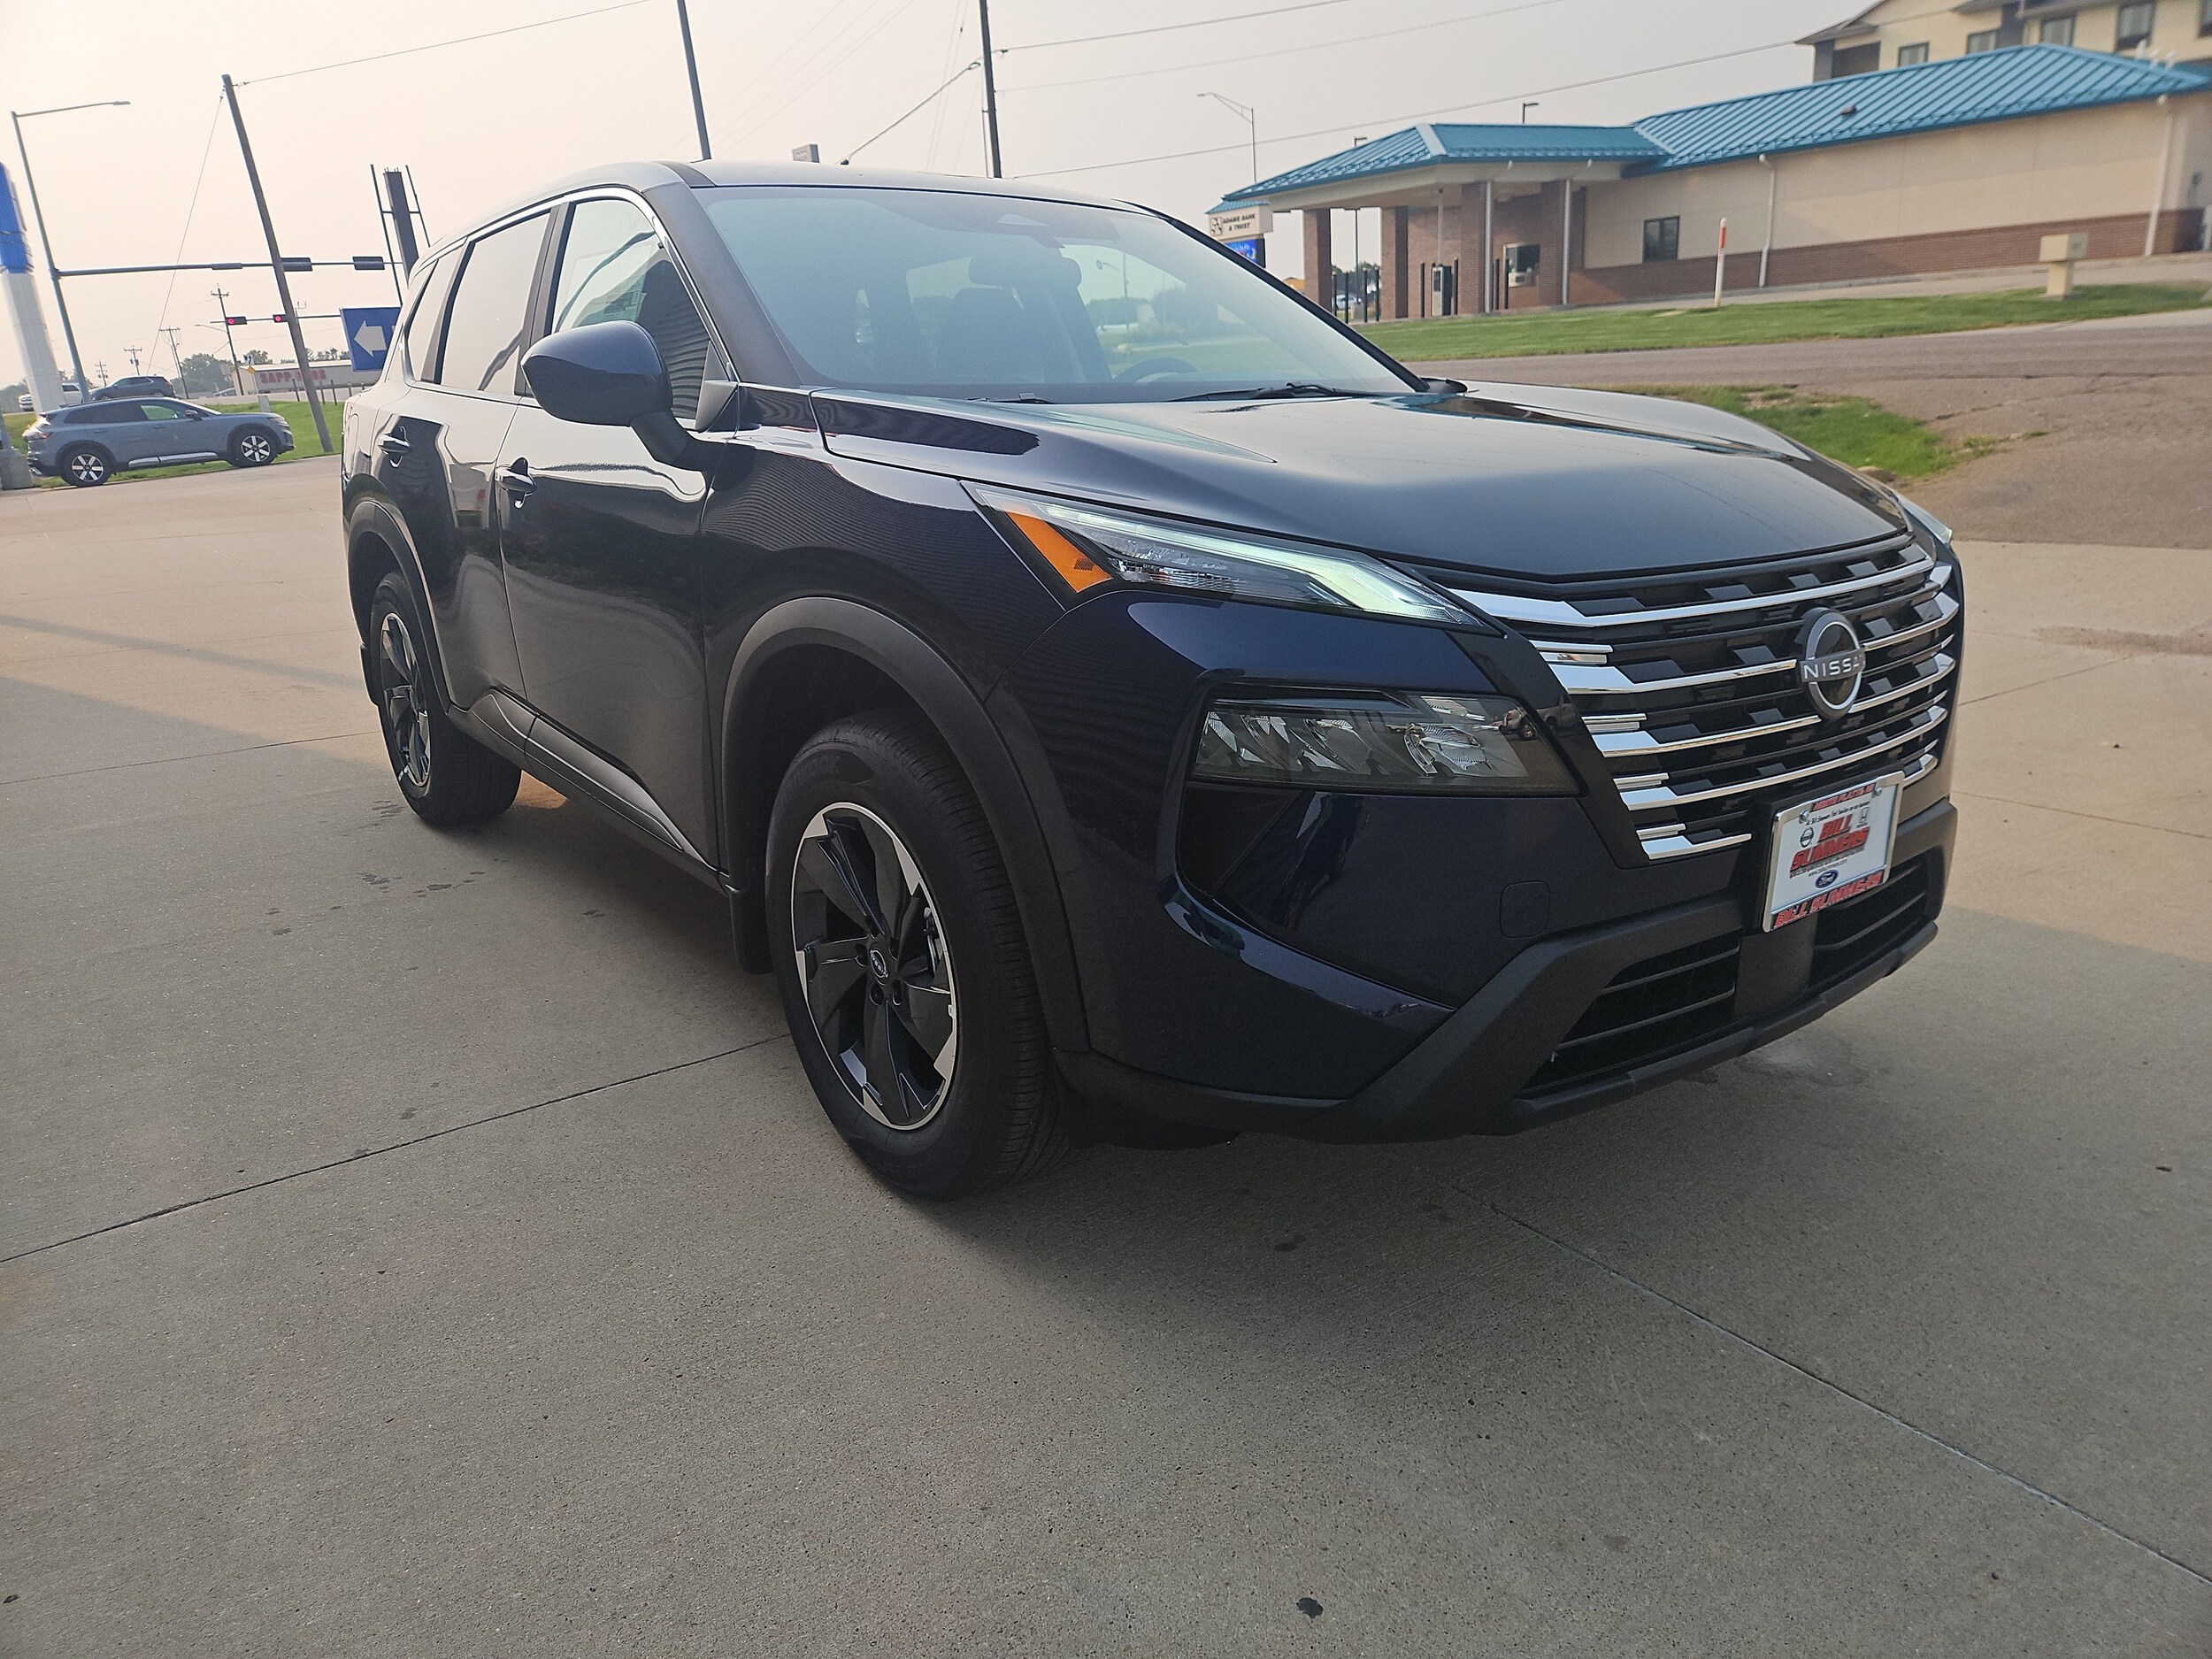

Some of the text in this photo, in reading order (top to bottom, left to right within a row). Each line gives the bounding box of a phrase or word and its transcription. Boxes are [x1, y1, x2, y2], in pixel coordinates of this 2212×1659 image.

[259, 371, 291, 383] SAPP
[1803, 655, 1865, 680] NISSA
[1818, 814, 1853, 841] BILL
[1790, 826, 1870, 871] SUMMERS
